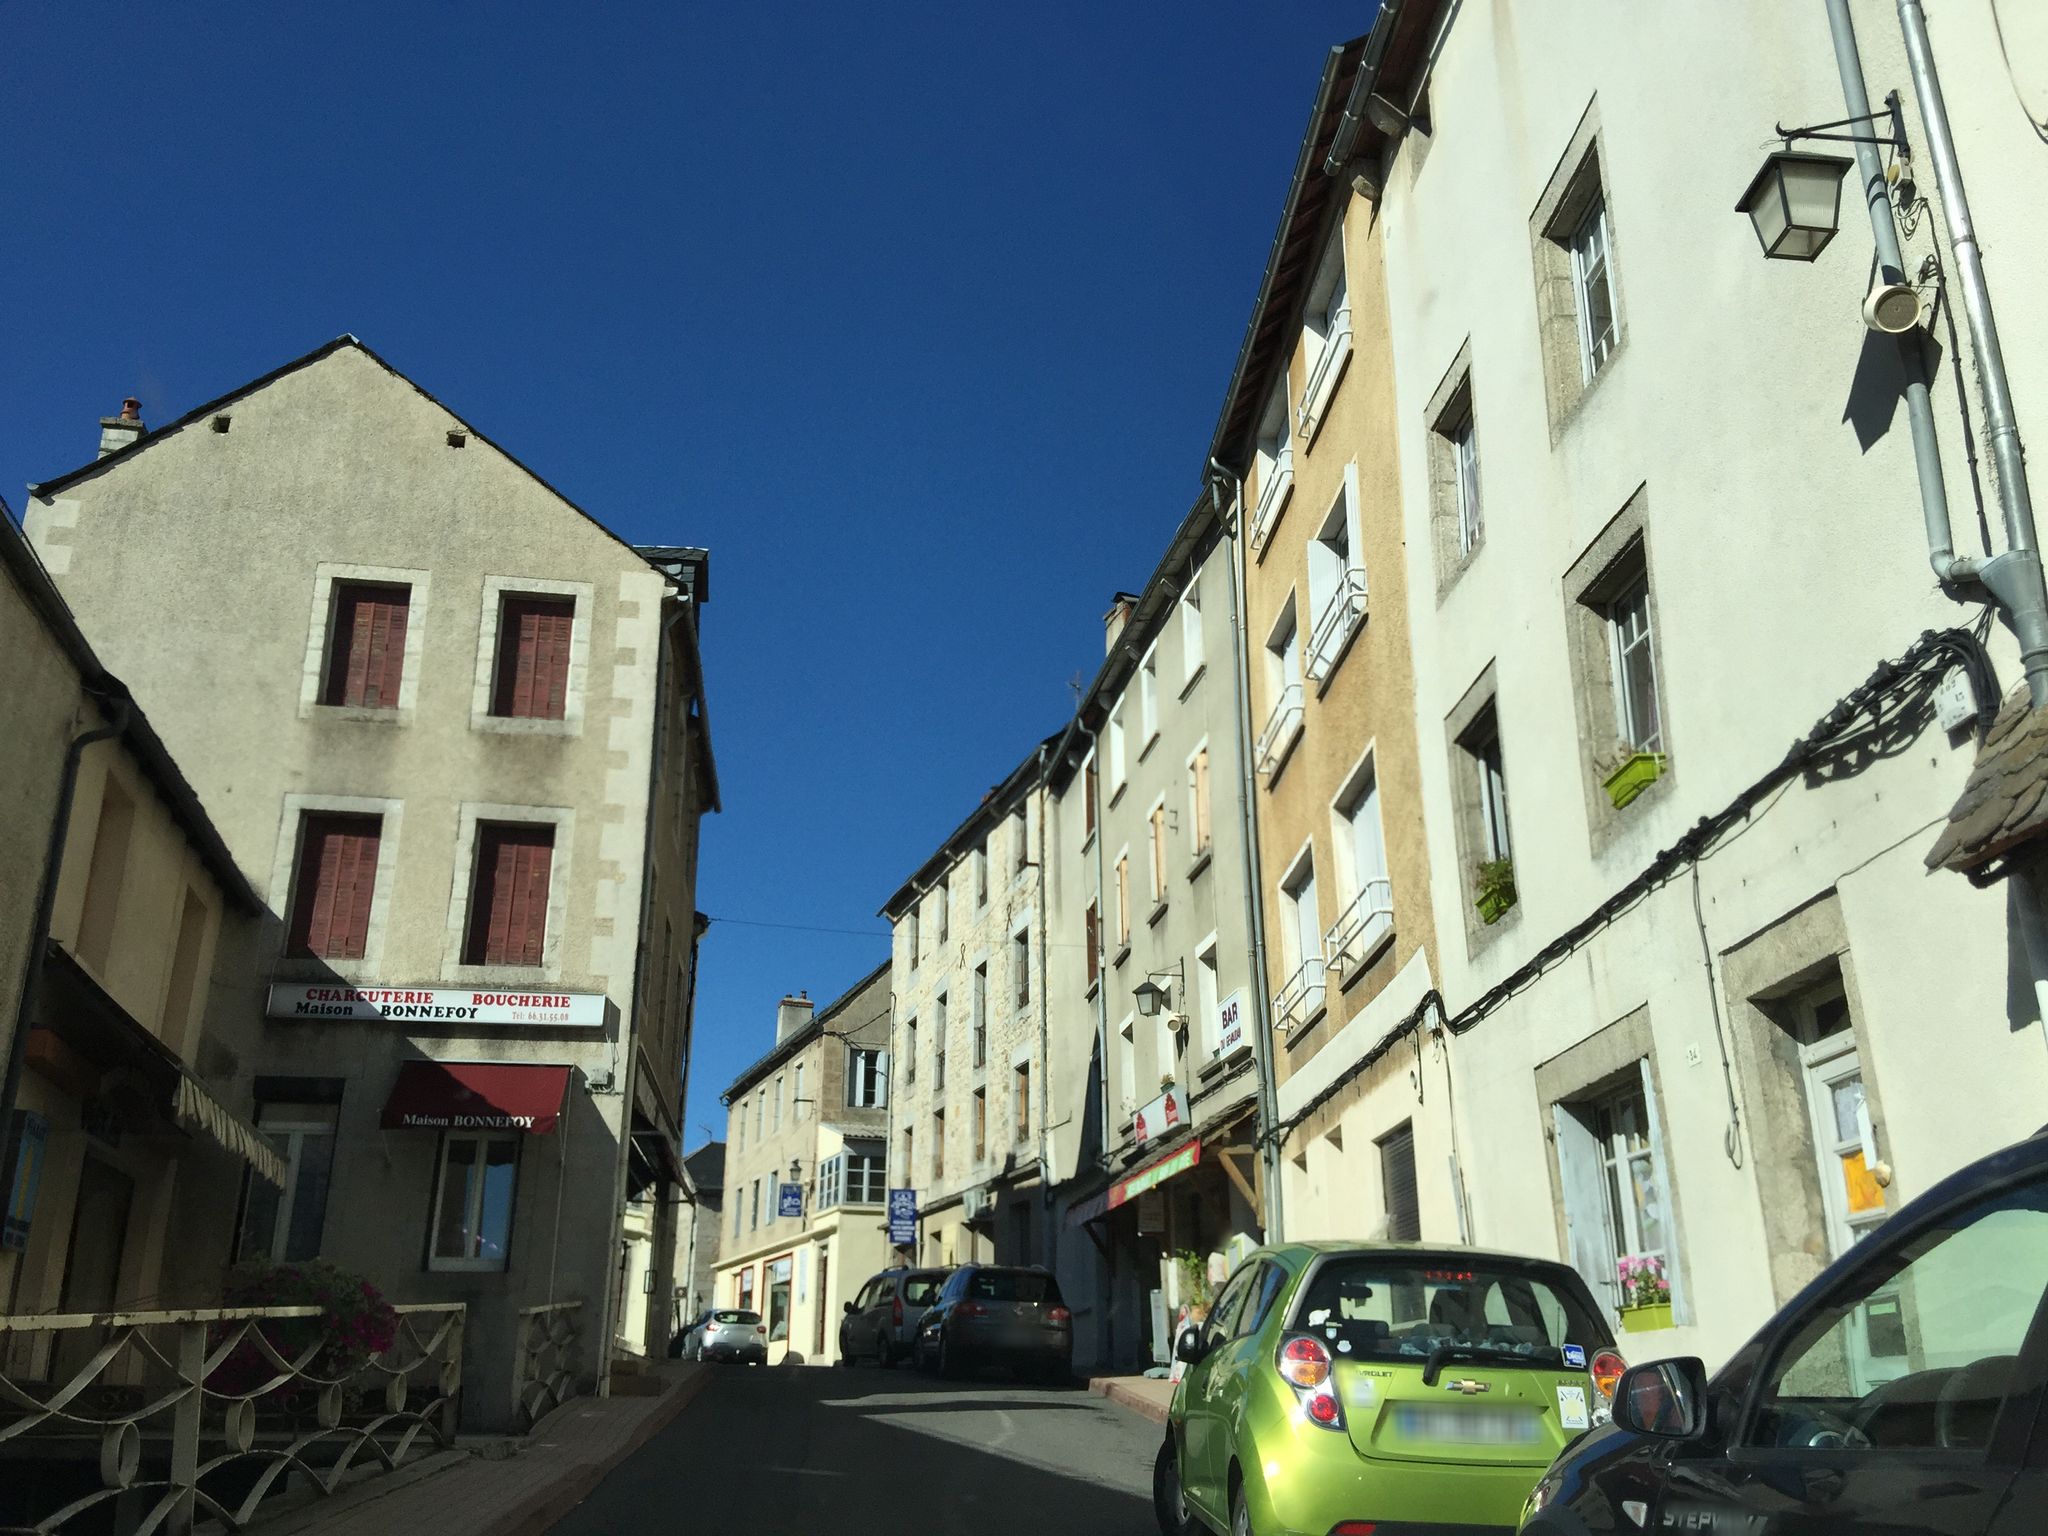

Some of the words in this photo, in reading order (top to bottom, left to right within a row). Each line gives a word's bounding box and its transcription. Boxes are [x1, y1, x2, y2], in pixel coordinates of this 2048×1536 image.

[306, 988, 434, 1004] CHARCUTERIE
[472, 993, 571, 1008] BOUCHERIE
[295, 1002, 353, 1016] Maison
[379, 1004, 479, 1019] BONNEFOY
[1222, 1002, 1238, 1029] BAR
[402, 1114, 449, 1126] Maison
[454, 1115, 535, 1128] BONNEFOY
